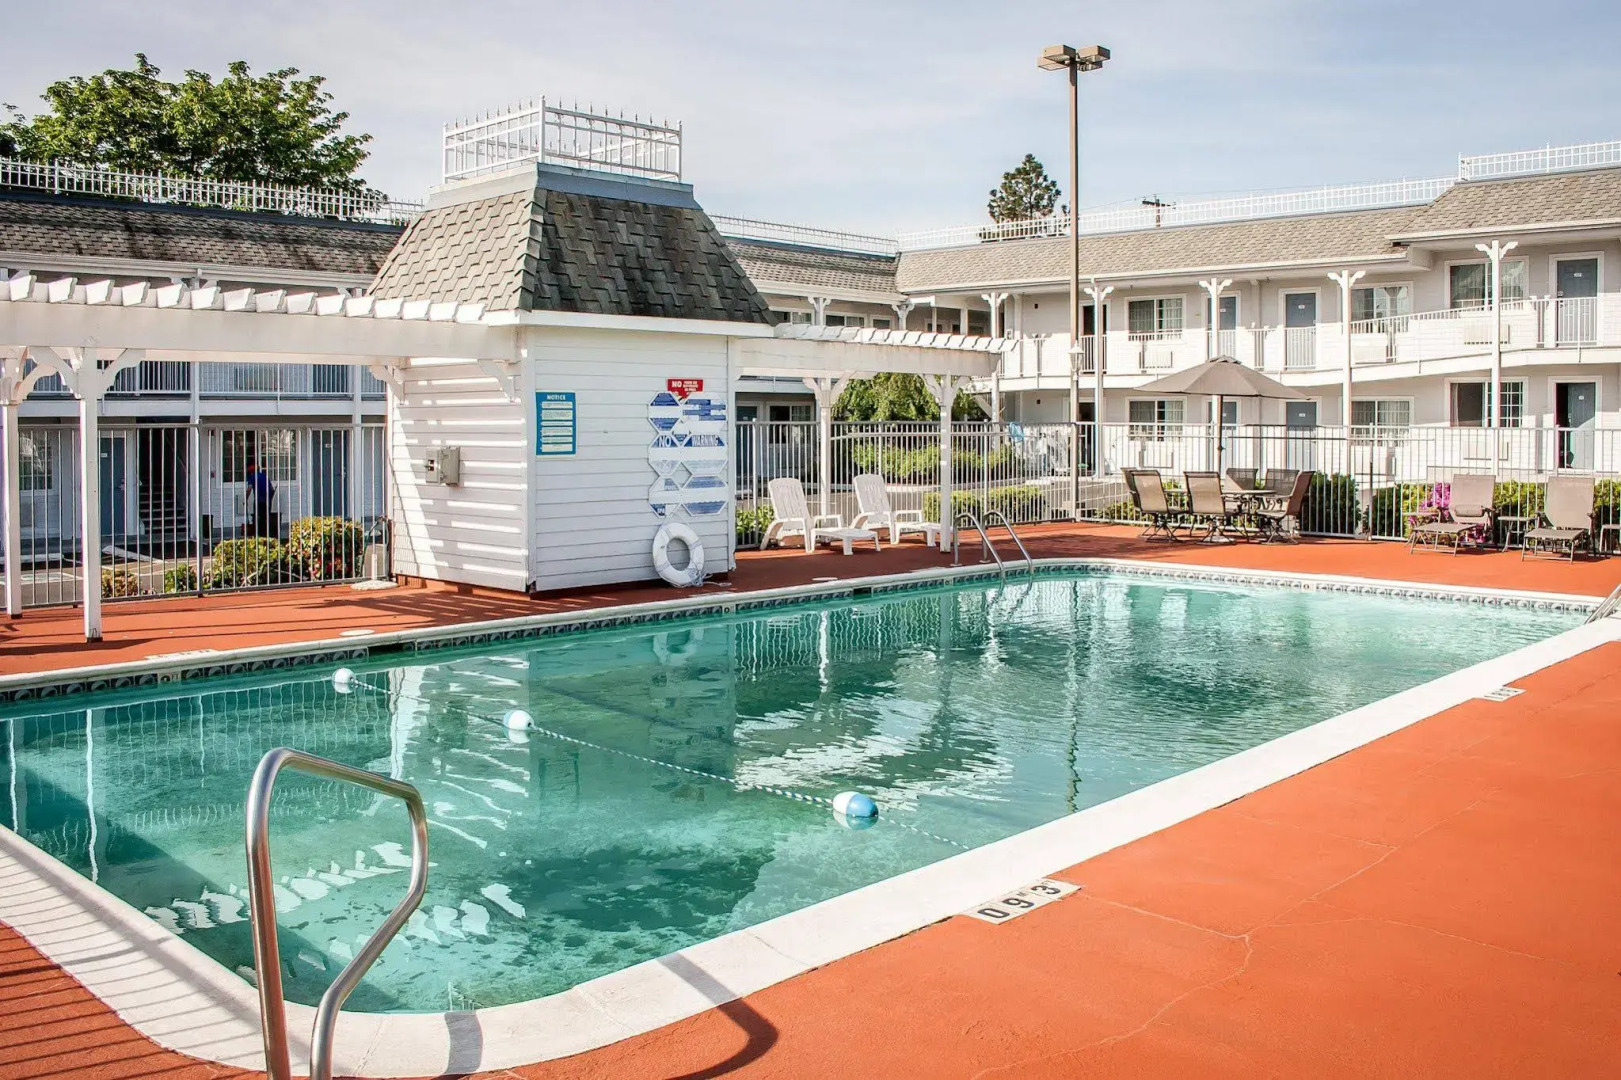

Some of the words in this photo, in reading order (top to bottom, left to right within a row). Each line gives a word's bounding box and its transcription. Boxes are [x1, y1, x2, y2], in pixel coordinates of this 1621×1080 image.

[671, 380, 682, 388] NO
[658, 435, 671, 447] NO
[691, 435, 719, 447] WARNING
